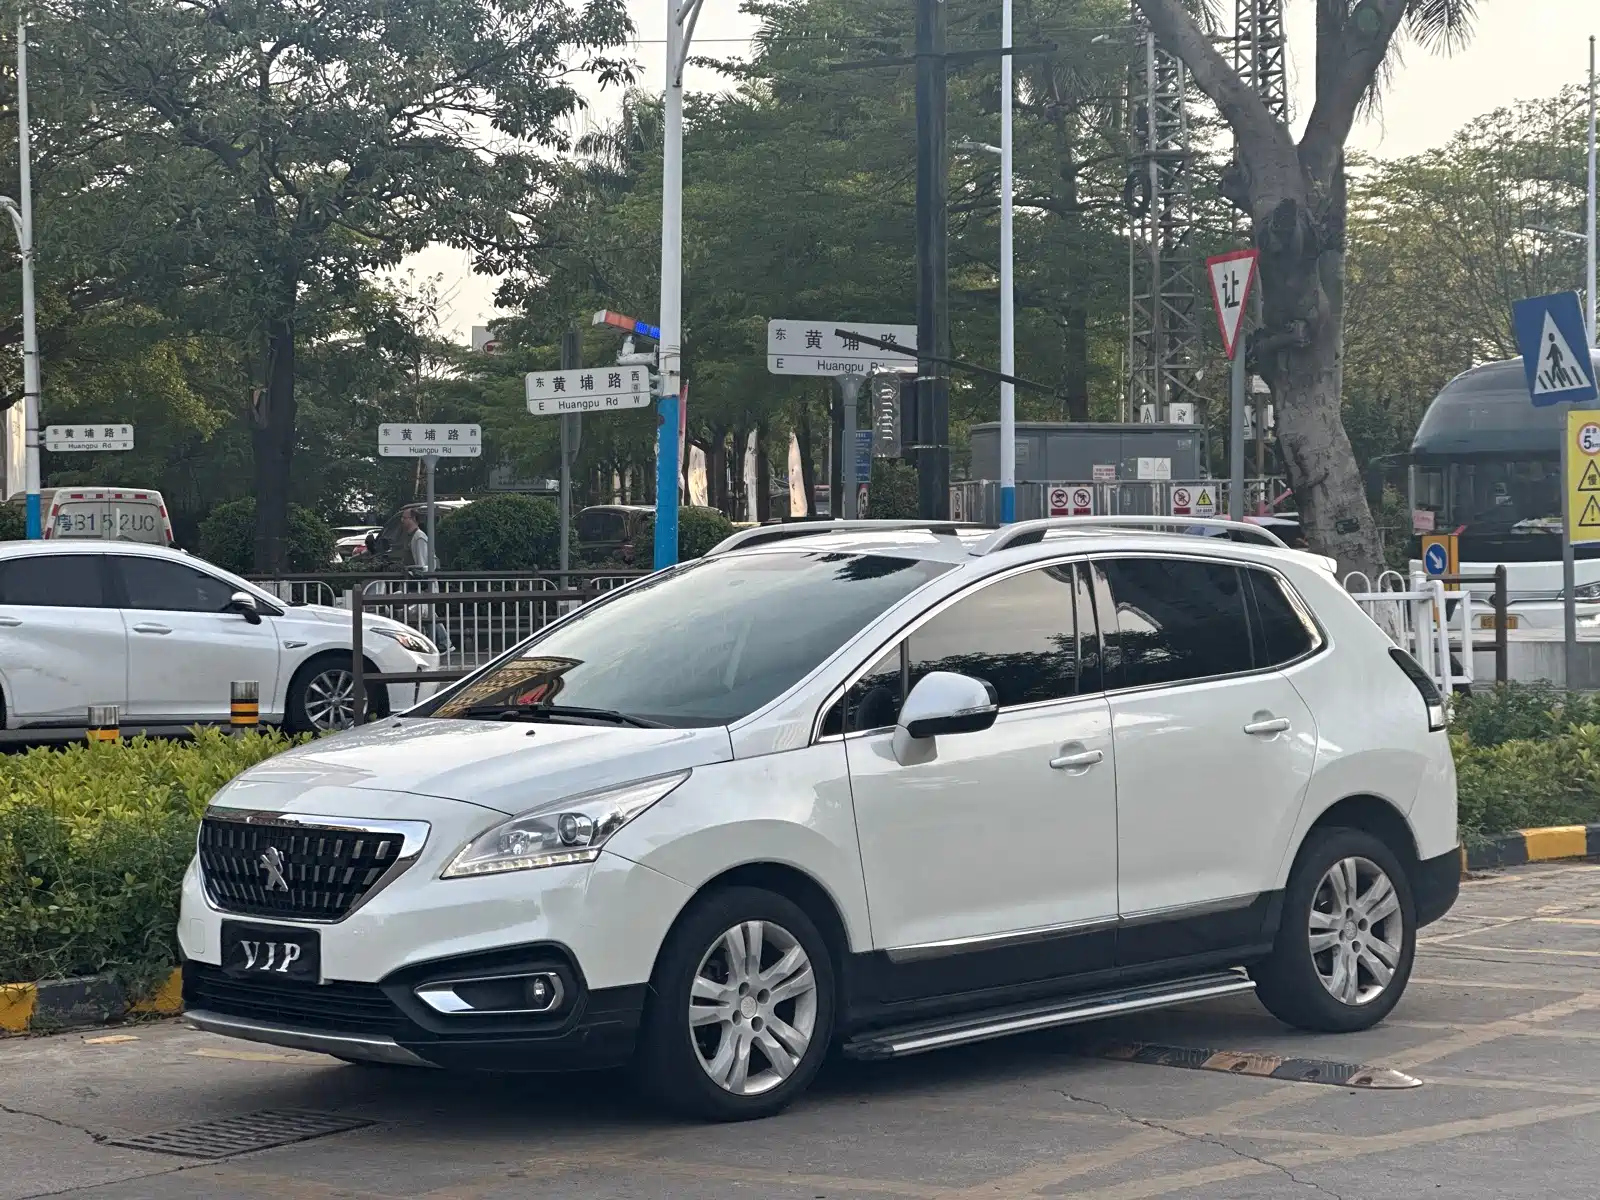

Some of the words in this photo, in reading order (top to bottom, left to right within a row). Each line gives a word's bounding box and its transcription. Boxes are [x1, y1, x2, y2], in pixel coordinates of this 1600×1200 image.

[1222, 270, 1240, 308] 让
[775, 327, 787, 341] 东
[776, 358, 785, 369] E
[817, 360, 864, 374] Huangpu
[536, 377, 545, 388] 东
[552, 372, 622, 392] 黄埔路
[631, 370, 640, 381] 西
[538, 402, 545, 411] E
[558, 399, 600, 410] Huangpu
[606, 397, 618, 406] Rd
[633, 395, 640, 404] W
[64, 427, 114, 439] 黄埔路
[383, 428, 390, 437] 东
[400, 428, 459, 441] 黄埔路
[469, 428, 477, 437] 西
[383, 446, 389, 454] E
[409, 446, 439, 455] Huangpu
[442, 446, 452, 454] Rd
[469, 446, 477, 454] W
[240, 940, 301, 972] VIP
